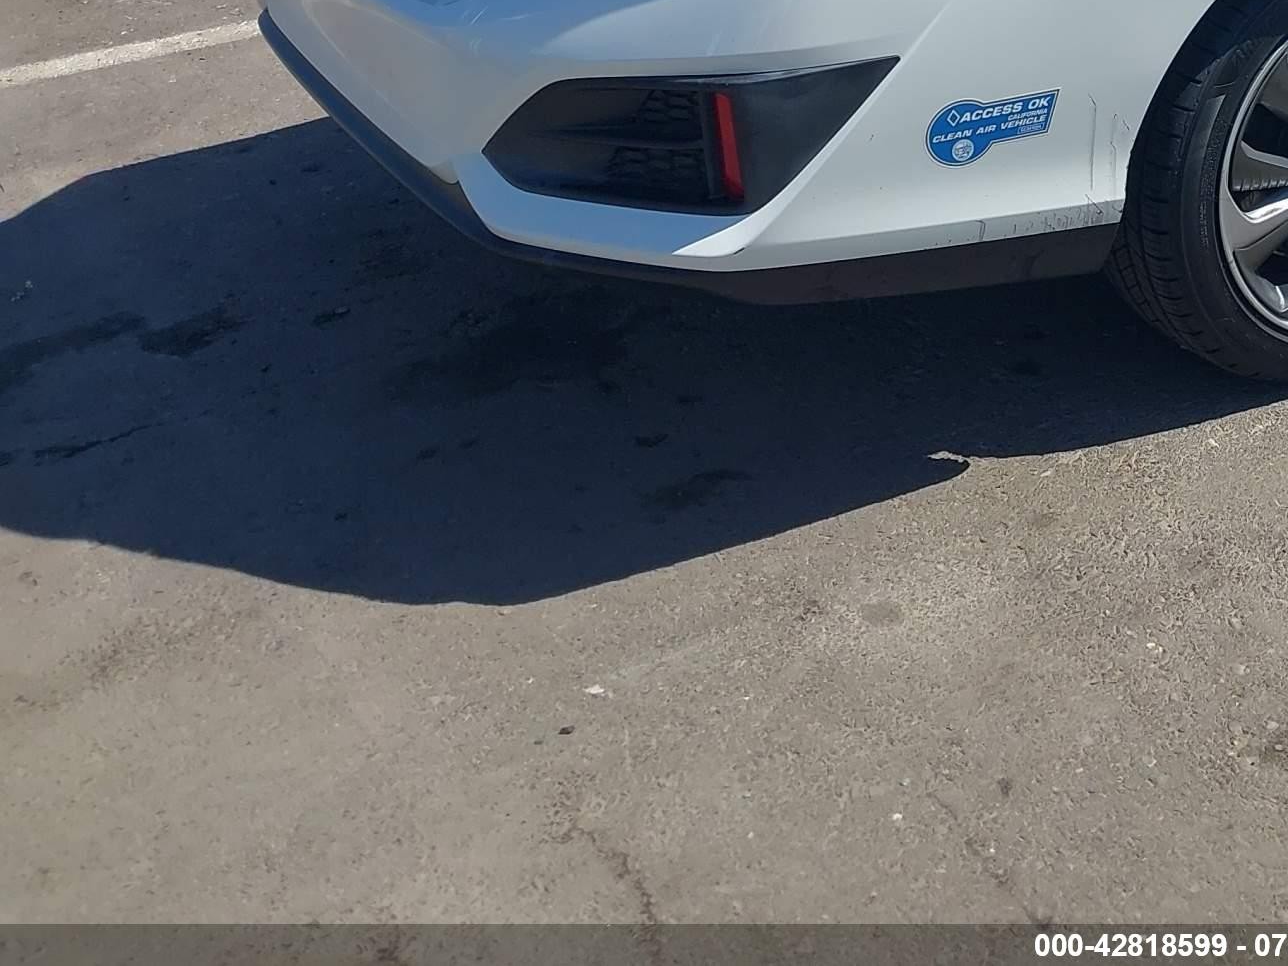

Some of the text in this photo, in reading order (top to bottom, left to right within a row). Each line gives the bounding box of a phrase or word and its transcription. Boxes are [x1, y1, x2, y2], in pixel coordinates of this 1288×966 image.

[960, 97, 1050, 123] ACCESS OK
[1008, 108, 1048, 121] CALIFORNIA
[932, 129, 973, 144] CLEAN
[975, 124, 997, 135] AIR
[1001, 114, 1047, 130] VEHICLE
